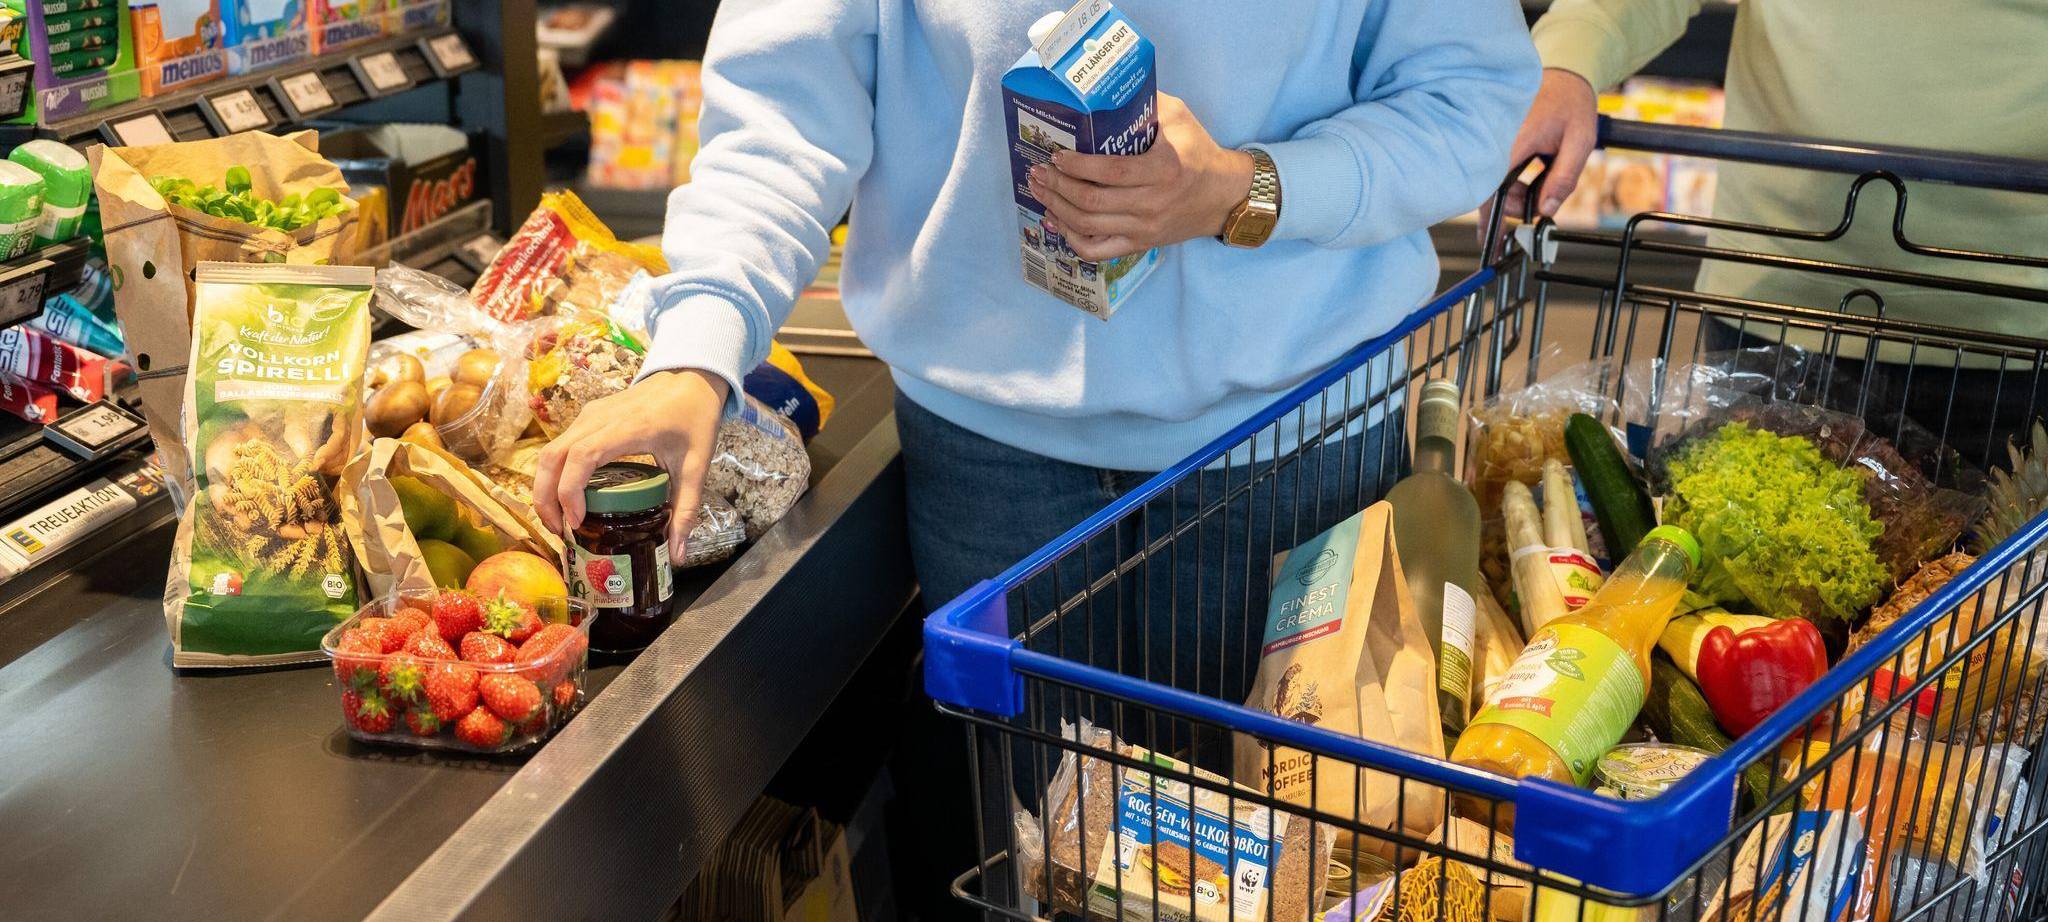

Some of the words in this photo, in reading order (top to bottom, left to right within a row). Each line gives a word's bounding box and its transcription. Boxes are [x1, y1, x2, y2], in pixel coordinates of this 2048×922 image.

[250, 33, 307, 63] mentos
[1072, 66, 1088, 84] OFT
[1088, 40, 1115, 70] LÄNGER
[1112, 26, 1128, 43] GUT
[161, 53, 223, 85] mentos
[1100, 96, 1153, 155] Tierwohl
[401, 157, 477, 236] Mars
[240, 325, 270, 343] Kraft
[217, 358, 350, 381] SPIRELLI
[228, 342, 340, 367] VOLLKORN
[29, 485, 120, 536] TREUEAKTION
[1280, 584, 1338, 616] FINEST
[1276, 602, 1335, 631] CREMA
[1262, 753, 1317, 780] NORDIC
[1239, 885, 1255, 895] WWF
